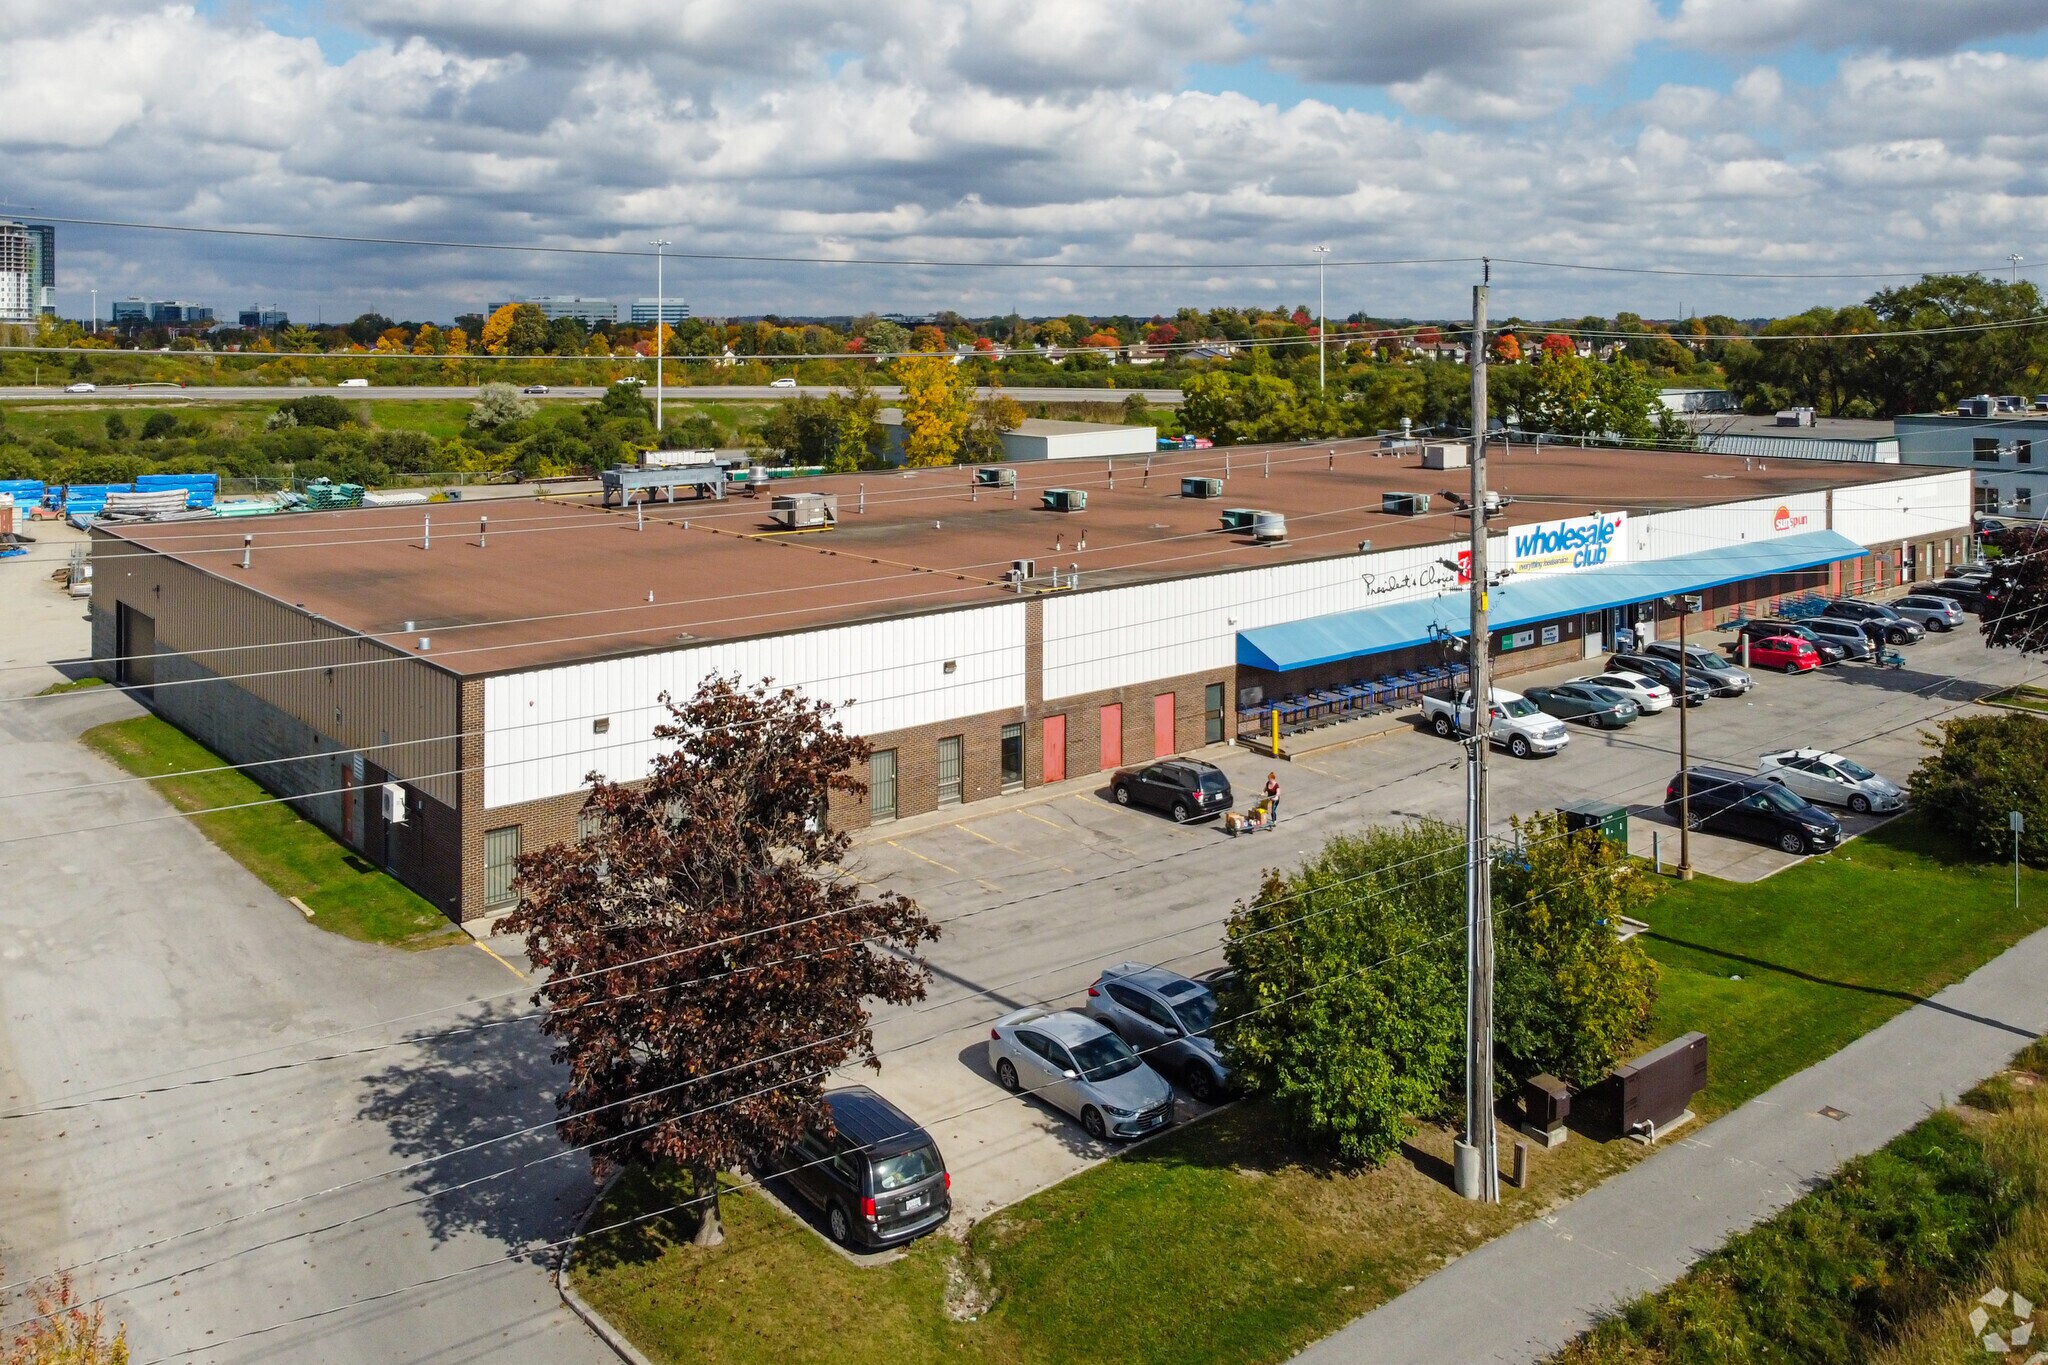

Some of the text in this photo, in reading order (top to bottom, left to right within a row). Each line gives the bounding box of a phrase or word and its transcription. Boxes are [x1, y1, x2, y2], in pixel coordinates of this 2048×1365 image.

[1515, 516, 1615, 558] wholesale
[1573, 541, 1608, 568] club
[1362, 573, 1417, 596] President's
[1420, 565, 1455, 587] Choice
